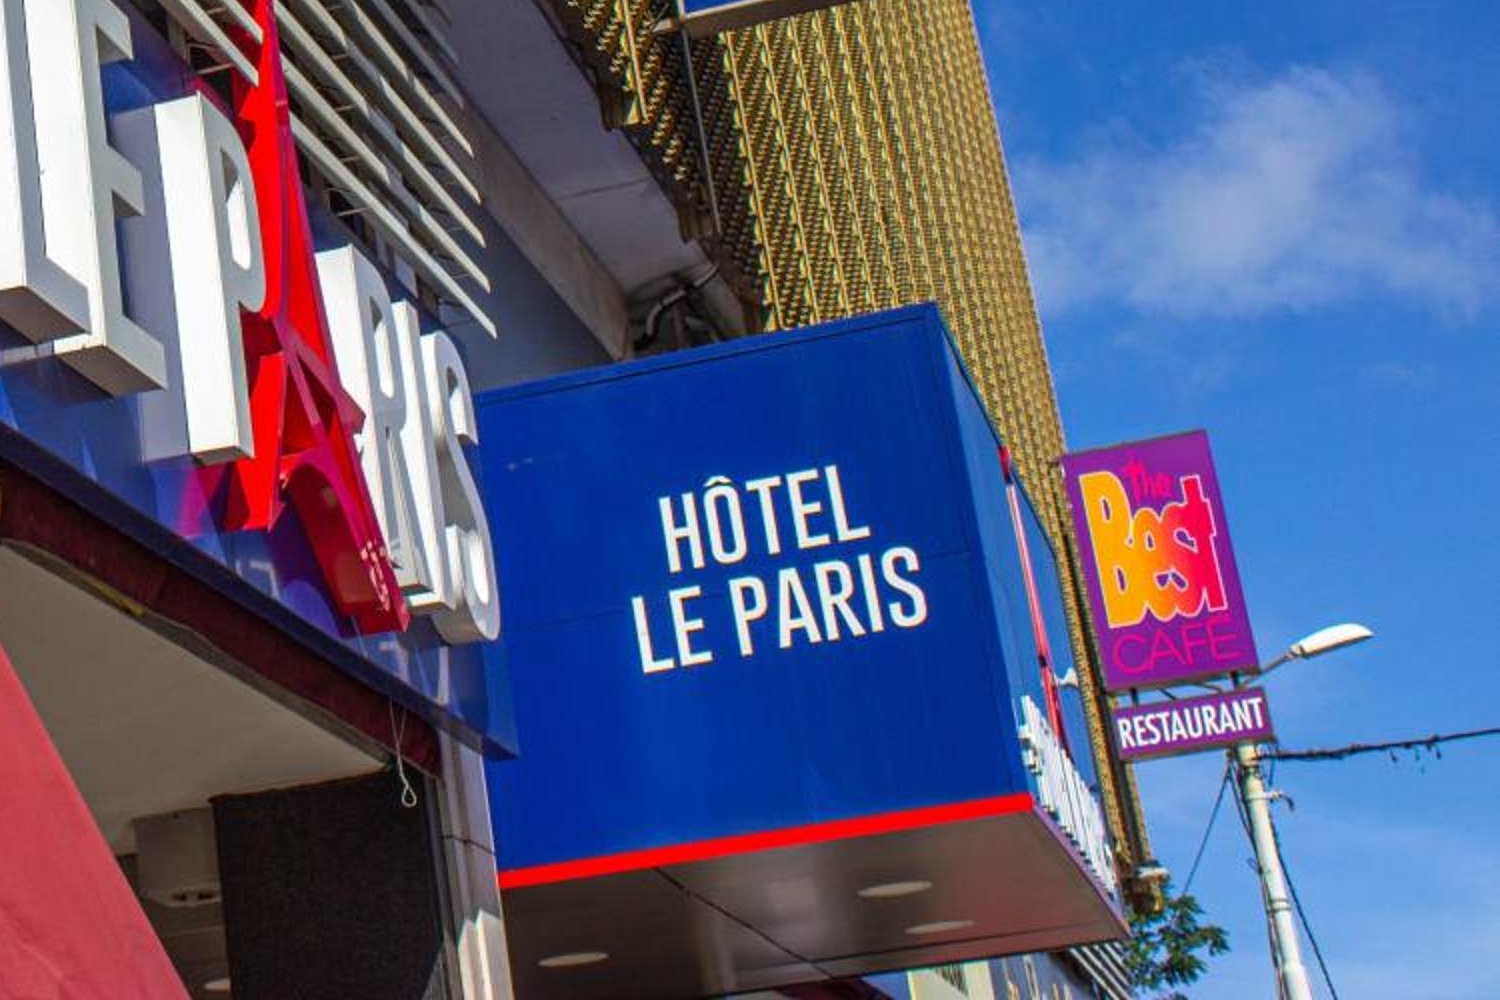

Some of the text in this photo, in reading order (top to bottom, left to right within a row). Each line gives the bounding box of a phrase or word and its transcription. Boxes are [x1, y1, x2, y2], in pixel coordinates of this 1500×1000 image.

[657, 464, 871, 572] HÔTEL
[631, 546, 929, 675] LE PARIS
[1117, 695, 1265, 749] RESTAURANT
